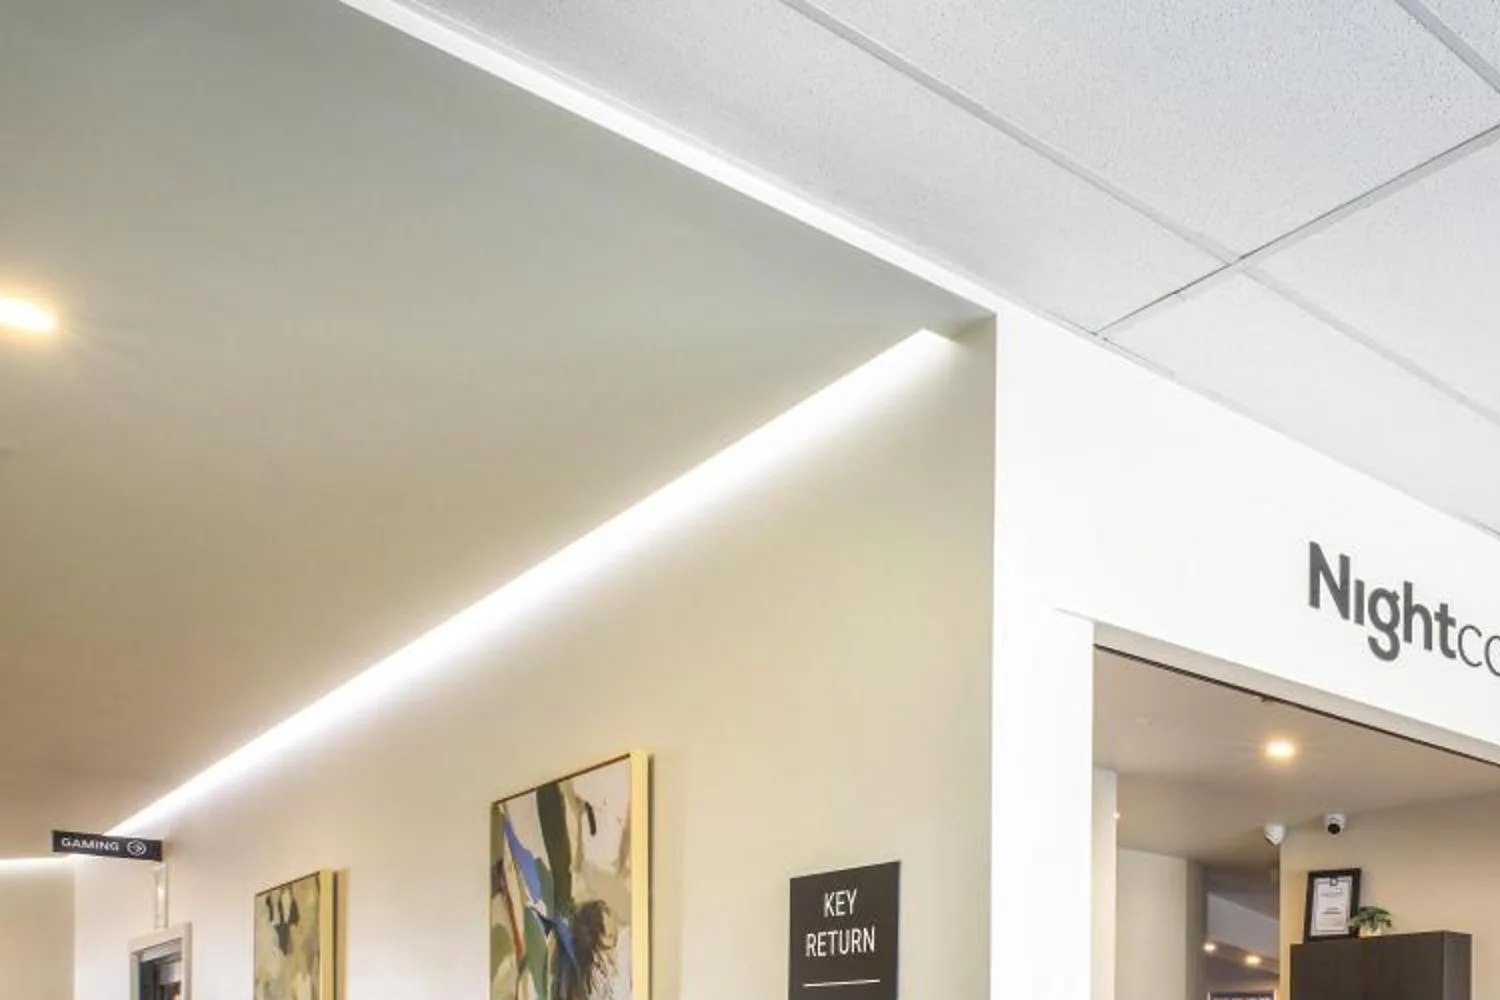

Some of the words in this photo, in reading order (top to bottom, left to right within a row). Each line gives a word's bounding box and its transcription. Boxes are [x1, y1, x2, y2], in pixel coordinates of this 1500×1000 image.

[61, 837, 120, 852] GAMING
[823, 888, 858, 918] KEY
[805, 926, 876, 957] RETURN
